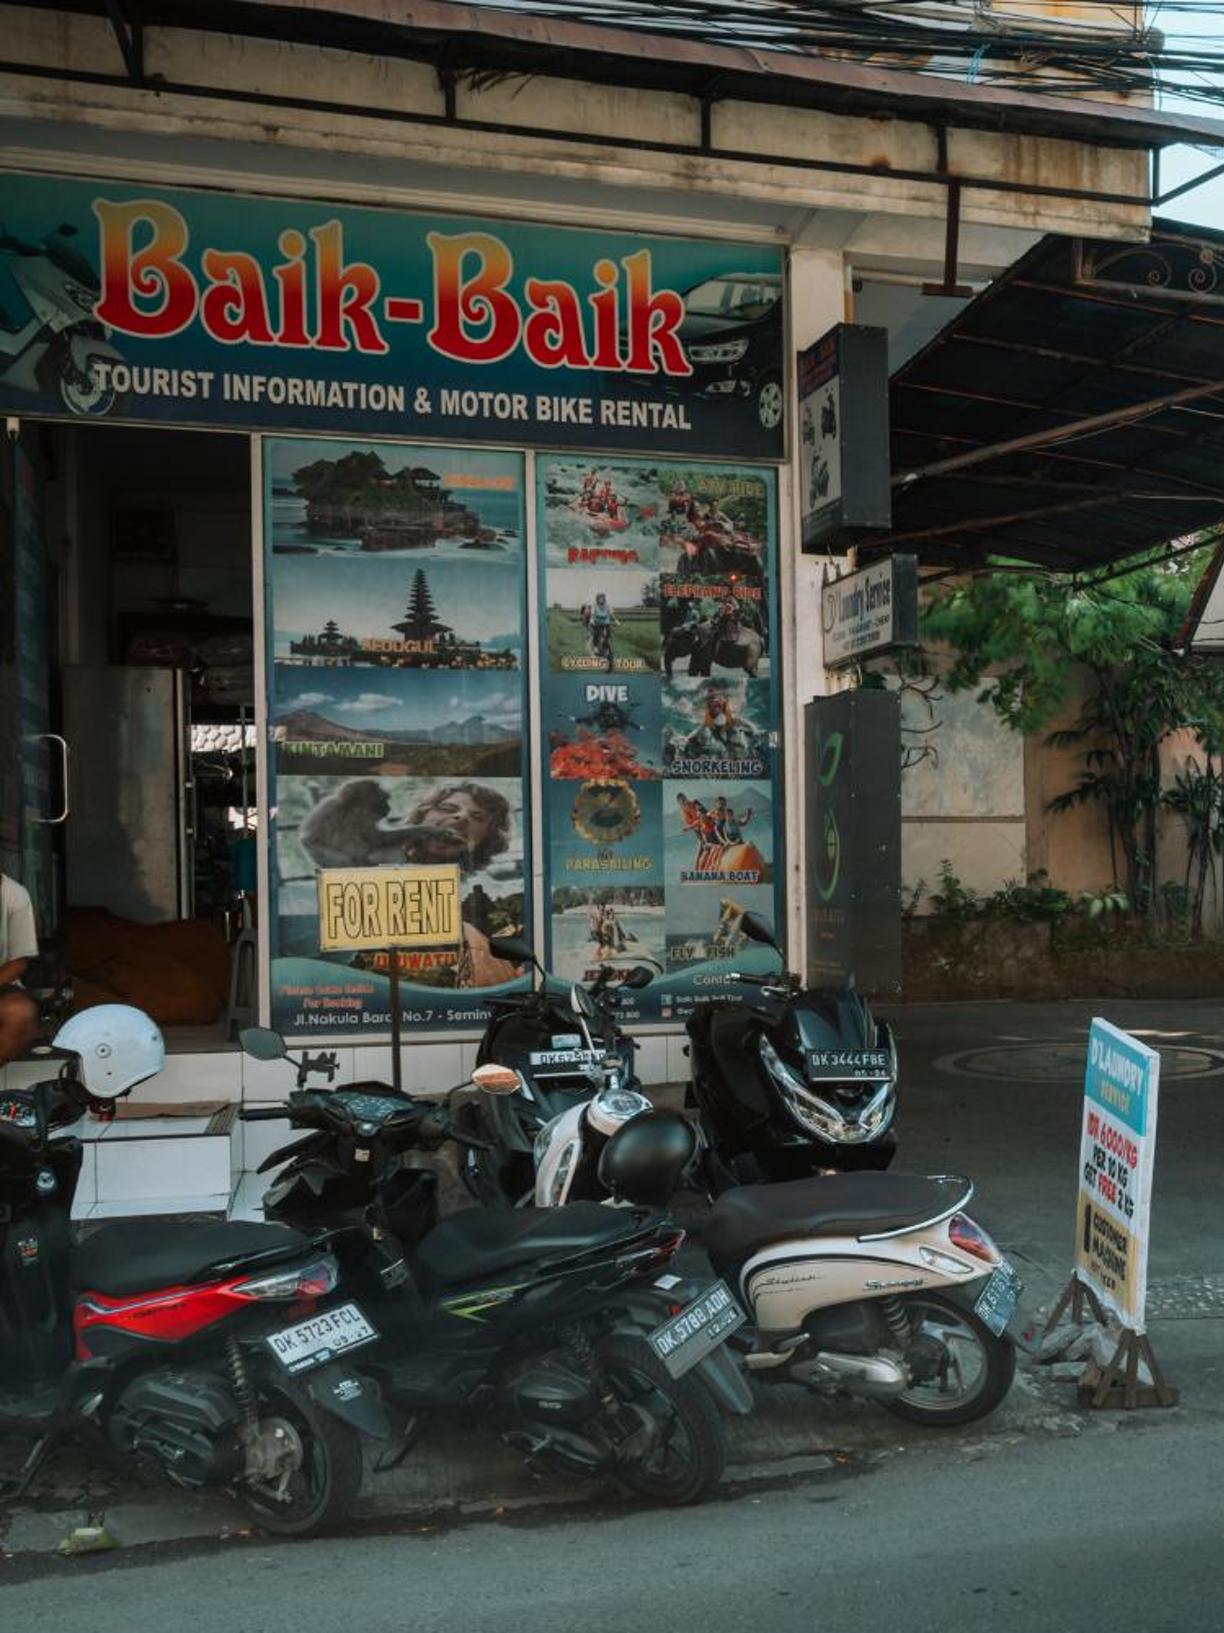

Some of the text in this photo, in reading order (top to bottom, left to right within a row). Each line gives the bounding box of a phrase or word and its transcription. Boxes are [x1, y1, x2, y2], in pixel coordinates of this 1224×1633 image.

[92, 197, 694, 378] Baik-Baik
[94, 364, 692, 430] TOURIST INFORMATION & MOTOR BIKE RENTAL
[586, 684, 628, 702] DIVE
[671, 758, 763, 775] SNORKELING
[729, 870, 759, 882] BOAT
[326, 878, 455, 940] FOR RENT
[403, 1010, 433, 1022] No.7
[812, 1053, 887, 1066] DK 3444 FBE
[1118, 1162, 1128, 1189] KG
[1118, 1189, 1124, 1211] 2
[1125, 1194, 1134, 1219] KG
[273, 1308, 360, 1353] DK 5723 FCL
[657, 1331, 678, 1354] DK
[674, 1307, 707, 1340] 5788
